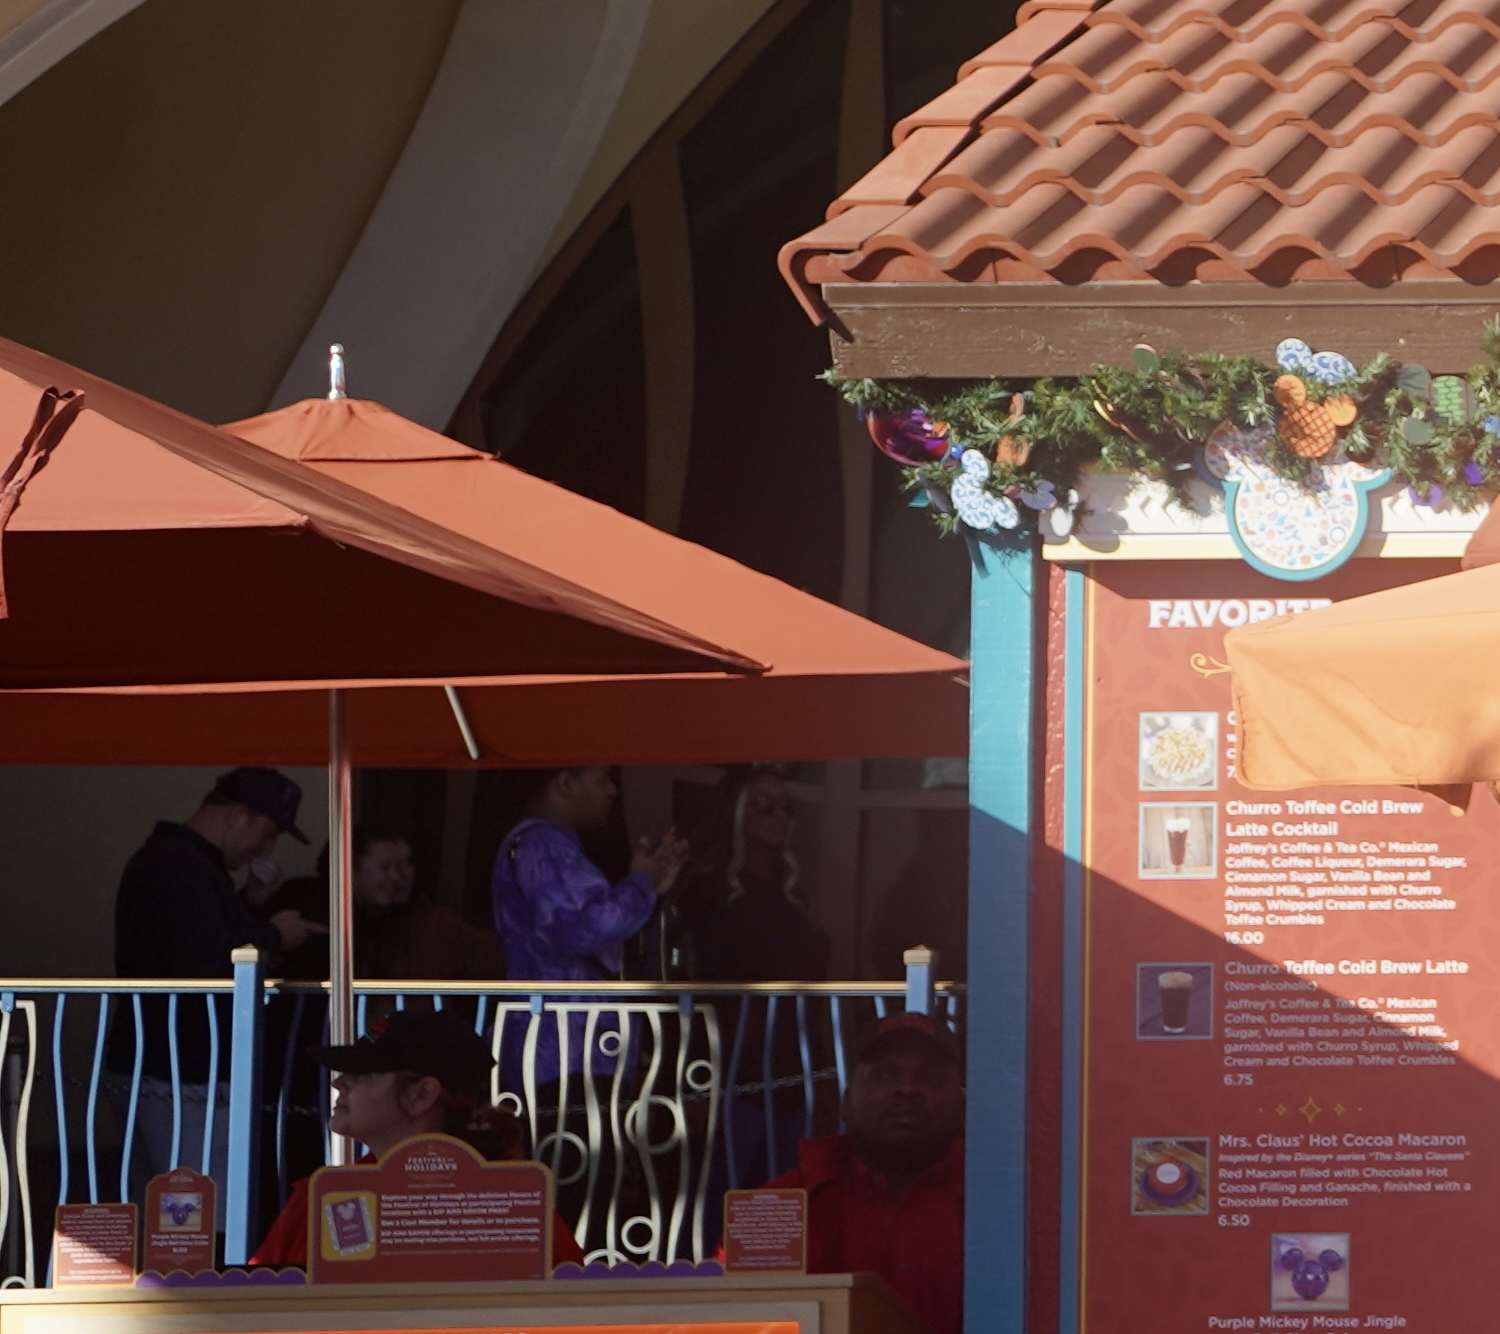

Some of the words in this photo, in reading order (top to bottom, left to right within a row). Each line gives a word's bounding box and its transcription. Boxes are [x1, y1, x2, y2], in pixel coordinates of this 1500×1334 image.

[1226, 801, 1282, 815] Churro
[1285, 800, 1337, 814] Toffee
[1340, 800, 1378, 814] Cold
[1382, 800, 1424, 814] Brew
[1226, 823, 1269, 836] Latte
[1272, 821, 1338, 836] Cocktail
[1225, 843, 1279, 855] Joffrey's
[1279, 843, 1322, 853] Coffee
[1322, 842, 1333, 853] &
[1336, 842, 1358, 853] Tea
[1388, 842, 1439, 853] Mexican
[1272, 857, 1313, 867] Coffee
[1366, 856, 1426, 867] Demerara
[1225, 871, 1288, 882] Cinnamon
[1330, 871, 1372, 881] Vanilla
[1373, 871, 1405, 881] Bean
[1406, 870, 1431, 881] and
[1225, 886, 1274, 897] Almond
[1307, 885, 1368, 897] garnished
[1369, 885, 1398, 895] with
[1399, 885, 1442, 895] Churro
[1266, 899, 1324, 911] Whipped
[1324, 899, 1366, 910] Cream
[1367, 899, 1392, 910] and
[1393, 899, 1456, 909] Chocolate
[1225, 914, 1264, 925] Toffee
[1265, 914, 1324, 925] Crumbles
[1224, 931, 1264, 944] 16.00
[1224, 961, 1278, 975] Churro
[1284, 960, 1335, 974] Toffee
[1338, 960, 1377, 974] Cold
[1381, 960, 1422, 974] Brew
[1426, 960, 1468, 973] Latte
[1224, 1042, 1284, 1054] garnished
[1287, 1042, 1314, 1051] with
[1316, 1041, 1358, 1051] Churro
[1404, 1040, 1459, 1051] Whipped
[1224, 1056, 1264, 1066] Cream
[1266, 1057, 1290, 1066] and
[1292, 1056, 1354, 1066] Chocolate
[1357, 1055, 1395, 1065] Toffee
[1398, 1055, 1455, 1065] Crumbles
[1224, 1074, 1253, 1085] 6.75
[1219, 1135, 1251, 1147] Mrs.
[1256, 1134, 1304, 1147] Claus'
[1309, 1135, 1338, 1147] Hot
[1342, 1133, 1393, 1147] Cocoa
[1398, 1134, 1466, 1146] Macaron
[1218, 1169, 1242, 1179] Red
[1246, 1169, 1296, 1178] Macaron
[1300, 1168, 1330, 1178] filled
[1333, 1168, 1360, 1177] with
[1362, 1167, 1423, 1177] Chocolate
[1426, 1167, 1448, 1177] Hot
[1218, 1183, 1256, 1193] Cocoa
[1260, 1183, 1297, 1194] Filling
[1300, 1183, 1322, 1192] and
[1384, 1181, 1432, 1191] finished
[1434, 1181, 1461, 1191] with
[1464, 1183, 1471, 1191] a
[1218, 1197, 1279, 1207] Chocolate
[1282, 1197, 1348, 1206] Decoration
[1218, 1215, 1250, 1226] 6.50
[1208, 1317, 1255, 1329] Purple
[1260, 1317, 1308, 1329] Mickey
[1313, 1317, 1359, 1327] Mouse
[1363, 1315, 1406, 1329] Jingle
